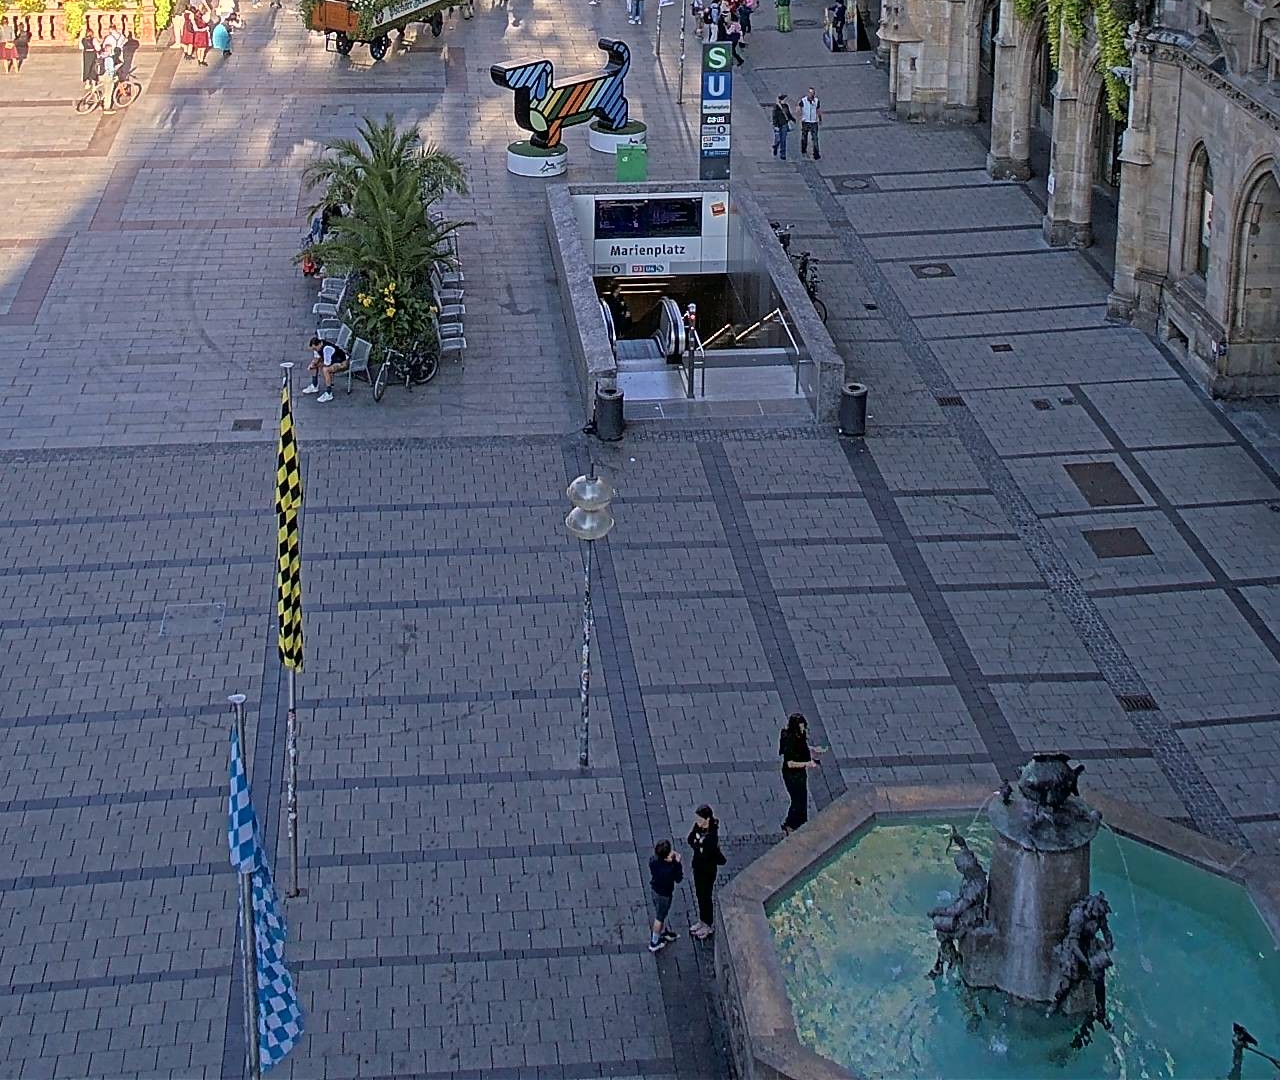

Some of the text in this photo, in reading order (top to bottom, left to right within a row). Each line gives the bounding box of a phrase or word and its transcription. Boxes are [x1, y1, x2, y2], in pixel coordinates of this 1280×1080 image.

[708, 47, 728, 69] S
[707, 75, 725, 97] U
[610, 244, 686, 258] Marienplatz
